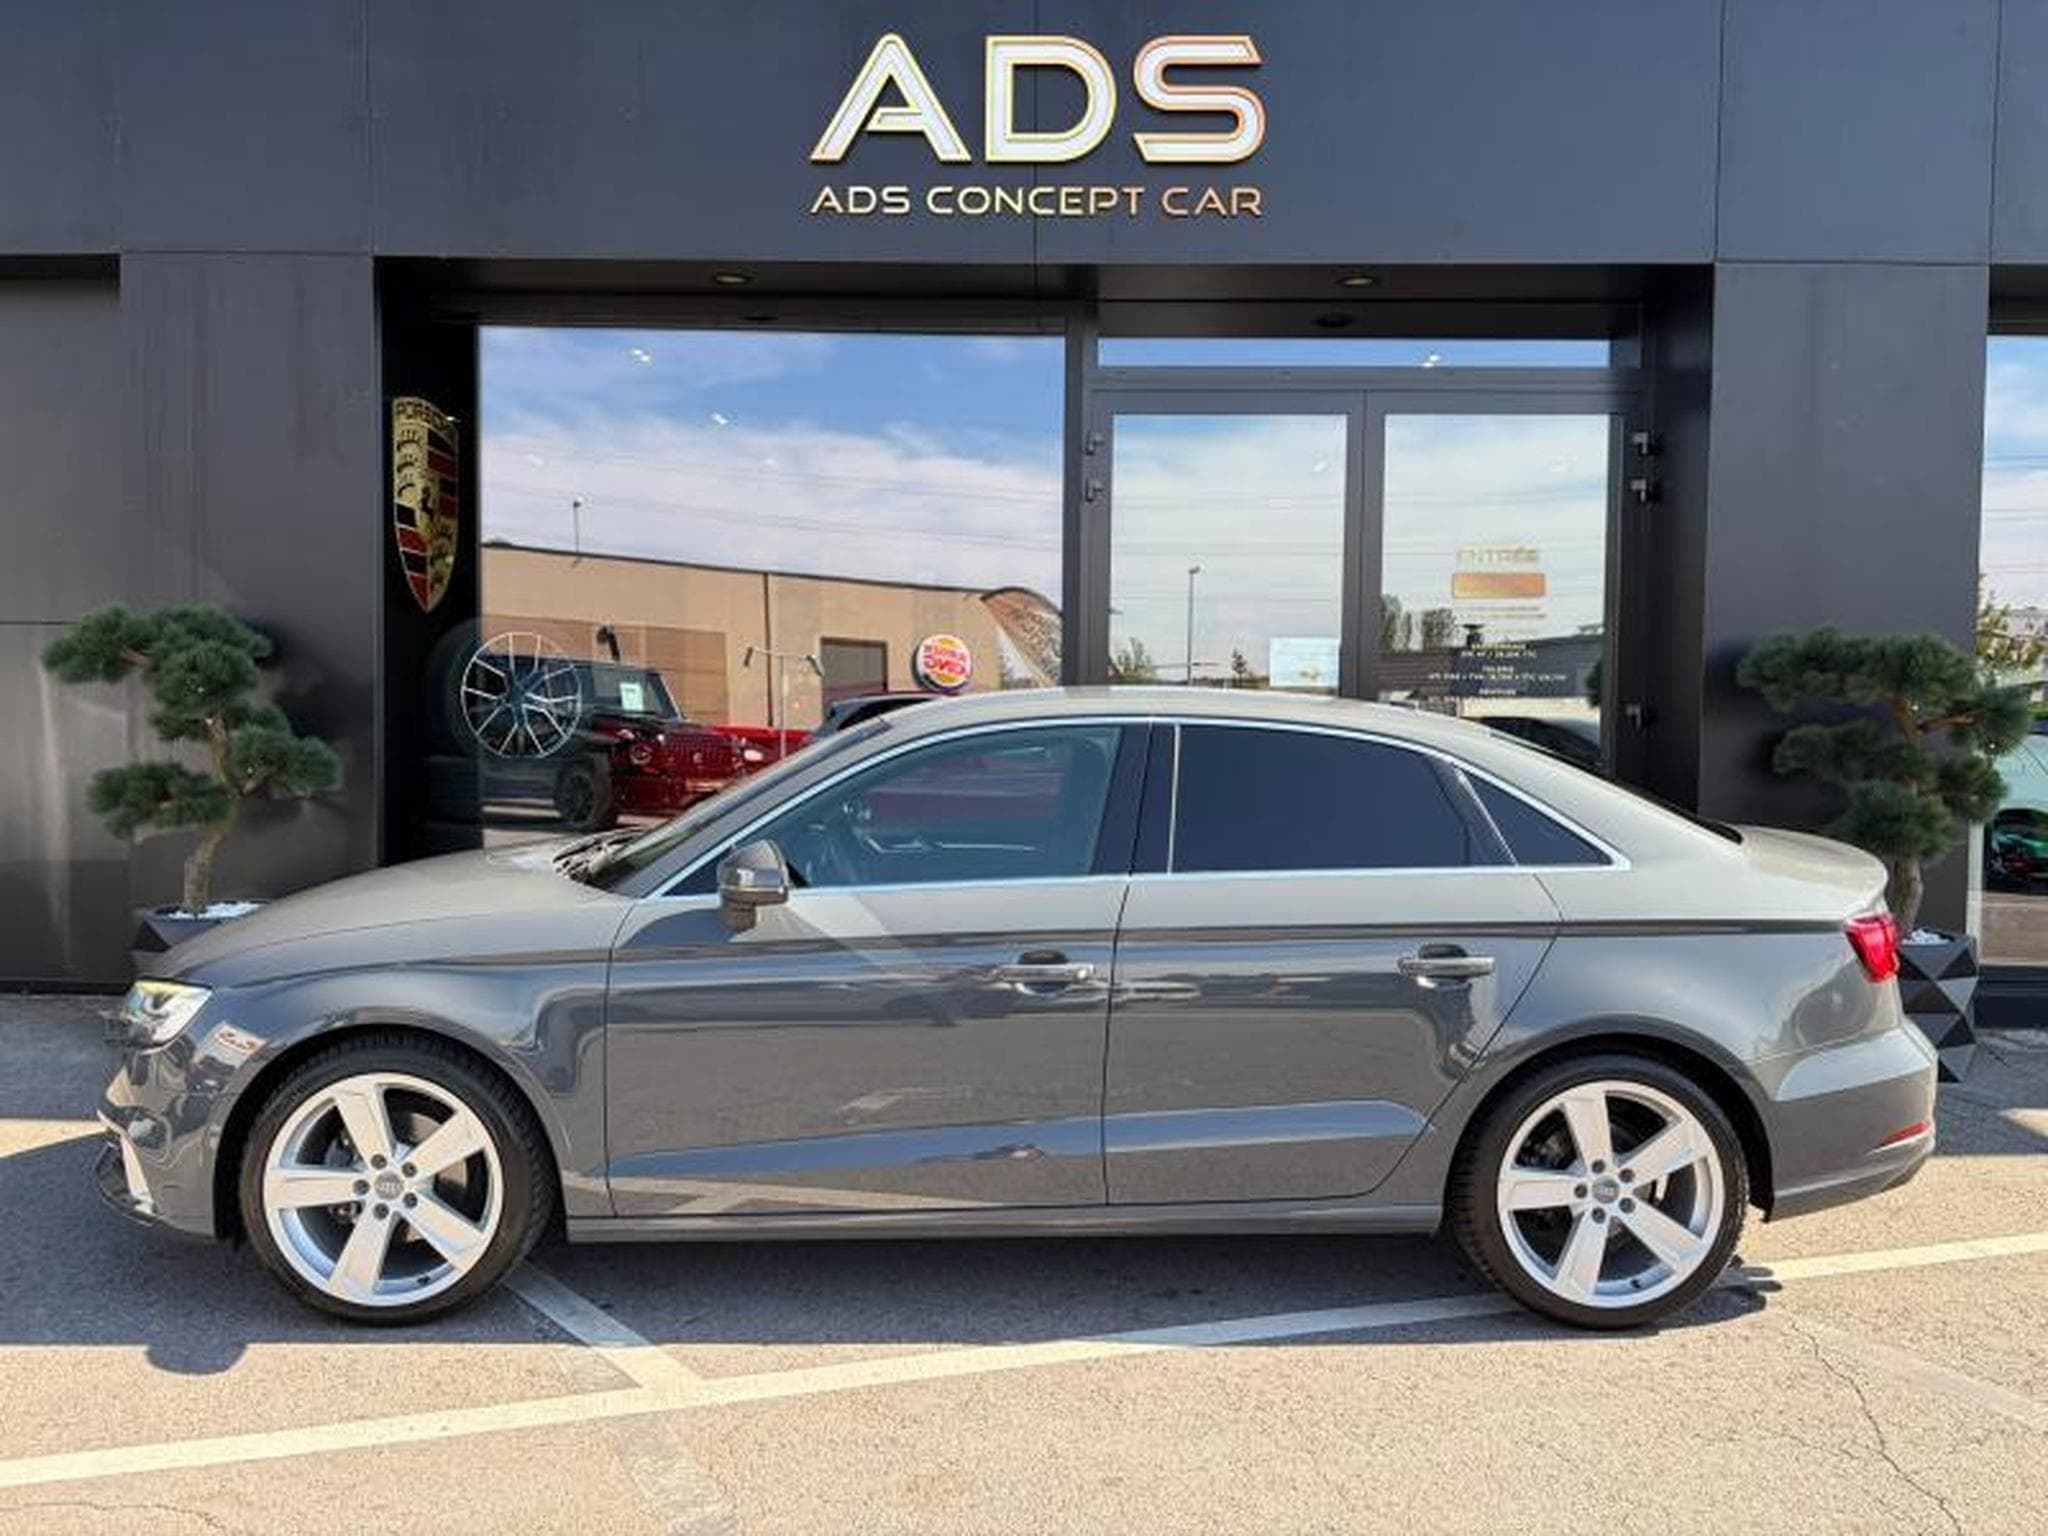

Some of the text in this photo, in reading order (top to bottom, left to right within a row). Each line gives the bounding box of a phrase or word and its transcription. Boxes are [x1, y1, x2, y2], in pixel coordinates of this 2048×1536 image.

[810, 33, 1266, 163] ADS
[810, 186, 1263, 216] ADS CONCEPT CAR
